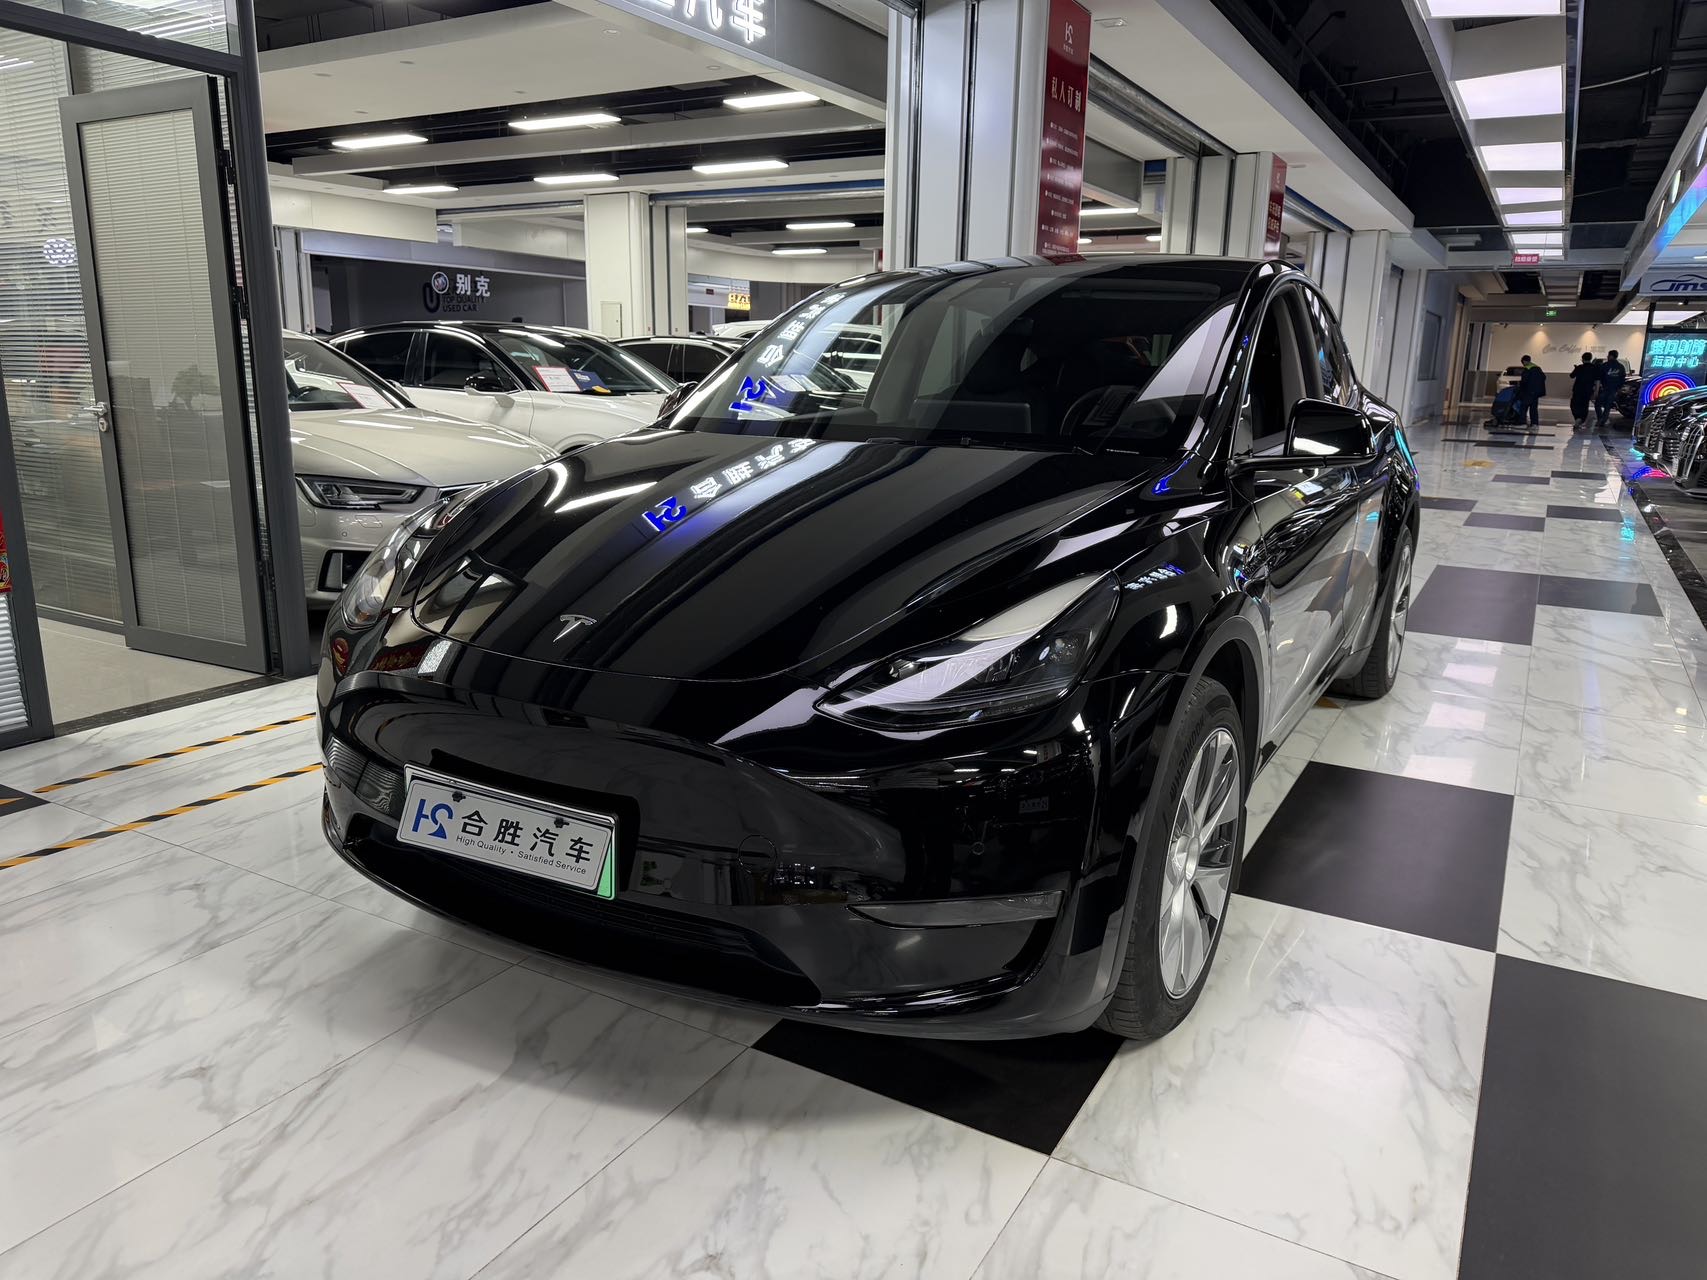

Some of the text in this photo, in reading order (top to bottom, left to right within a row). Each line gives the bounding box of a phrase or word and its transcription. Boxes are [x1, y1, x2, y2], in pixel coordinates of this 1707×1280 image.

[456, 273, 491, 297] 别克
[443, 304, 477, 313] USED CAR
[1650, 355, 1699, 368] 运动中心
[461, 810, 594, 864] 合胜汽车
[456, 835, 587, 875] High Quality Satisfied Service
